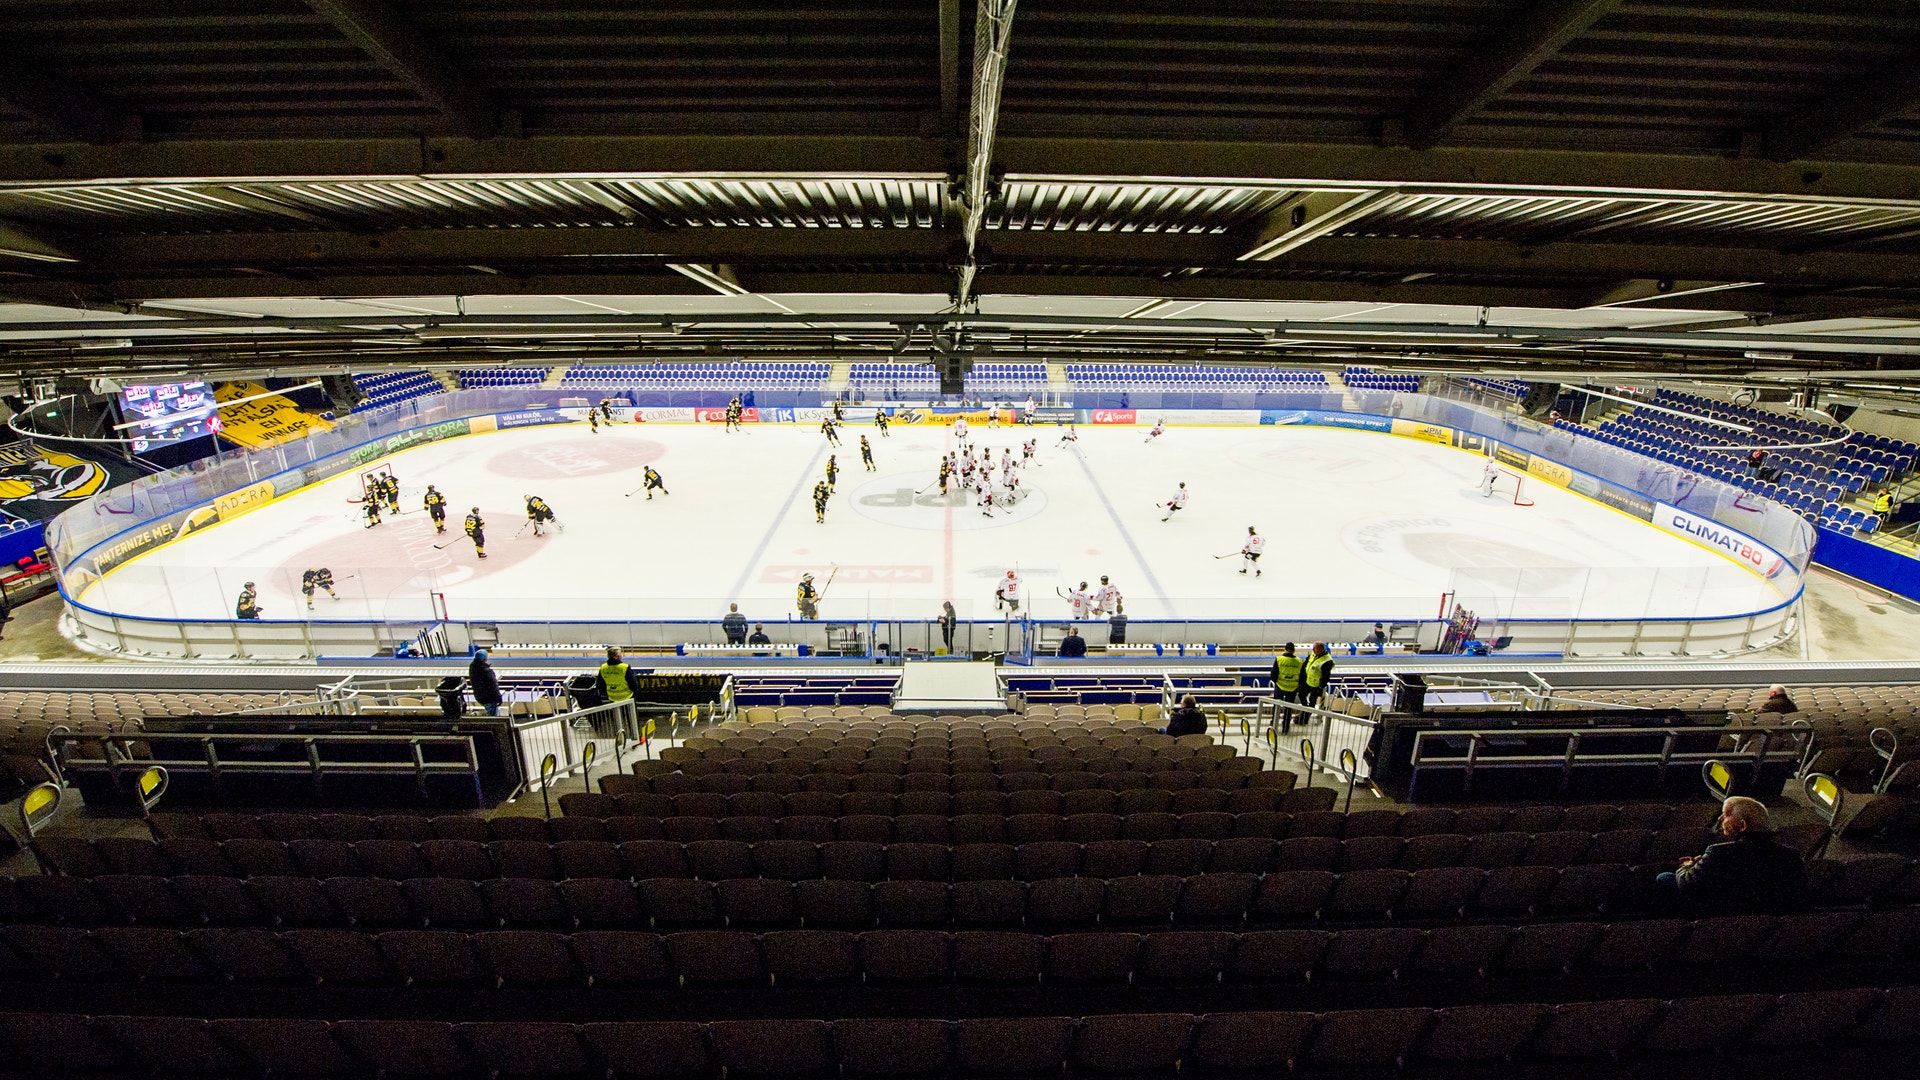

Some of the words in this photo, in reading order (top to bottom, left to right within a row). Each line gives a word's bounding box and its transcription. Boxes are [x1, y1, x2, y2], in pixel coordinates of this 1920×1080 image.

[646, 409, 689, 420] CORMAC
[710, 408, 754, 420] COAC
[811, 409, 848, 420] Systes
[1112, 411, 1133, 421] Sports
[259, 418, 283, 429] EN
[426, 420, 464, 438] STORA
[1425, 426, 1442, 435] JPM
[350, 441, 379, 462] STORA
[221, 486, 268, 512] ADERA
[93, 531, 151, 566] PANTERNIZE
[152, 523, 174, 539] ME!
[1672, 515, 1763, 566] CLIMAT80
